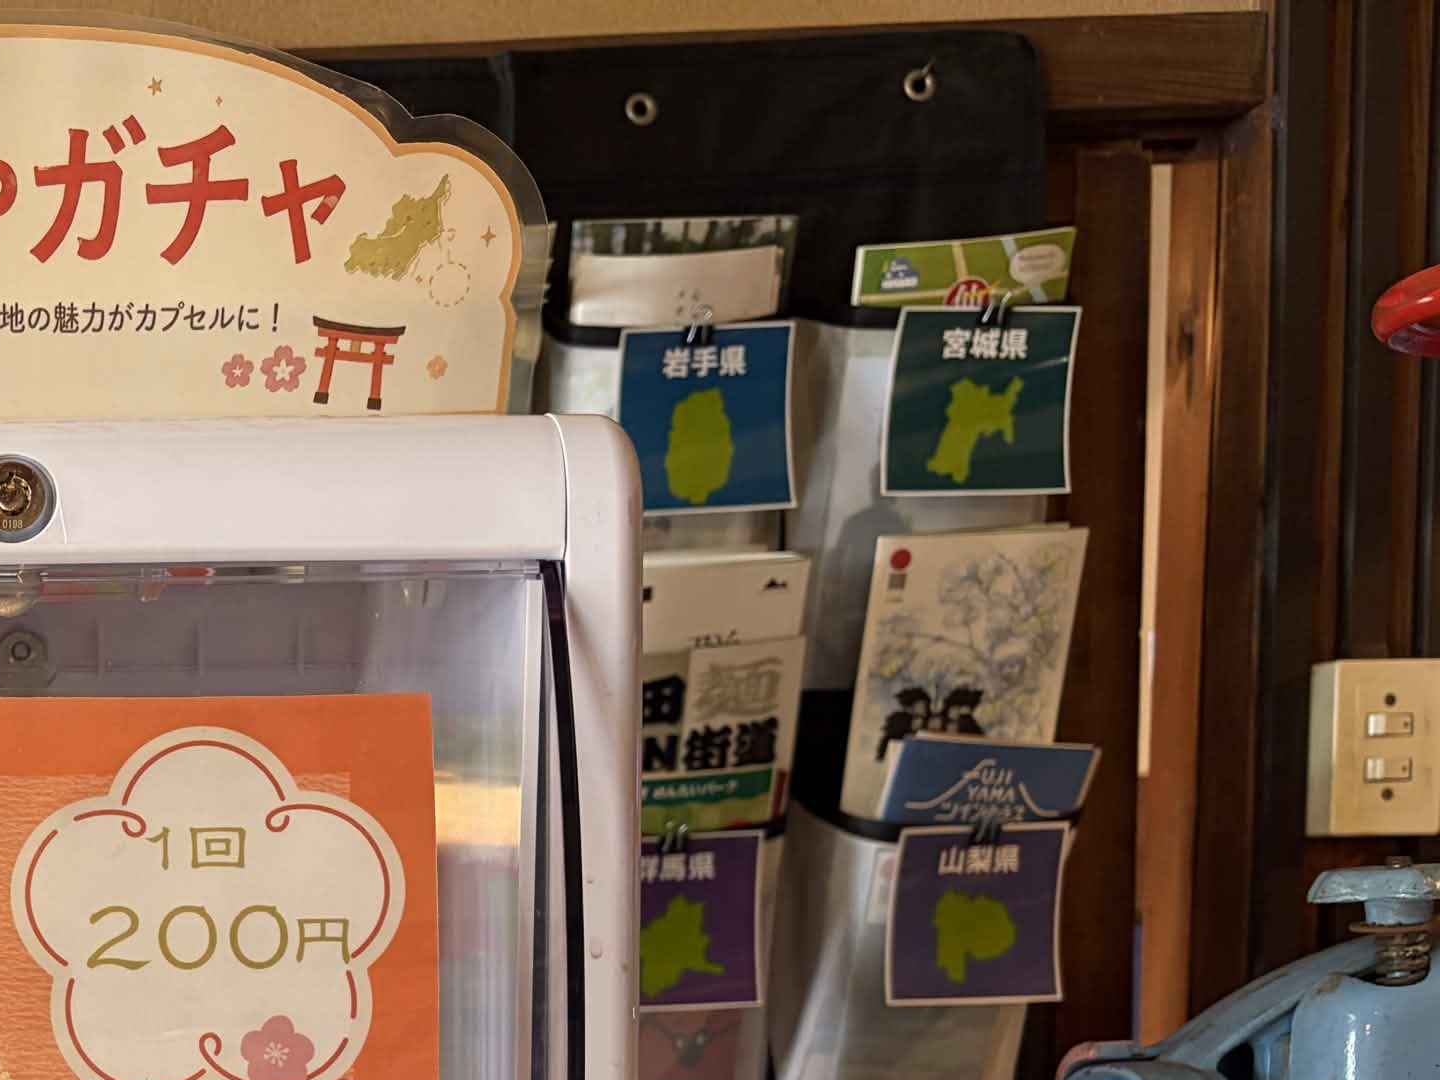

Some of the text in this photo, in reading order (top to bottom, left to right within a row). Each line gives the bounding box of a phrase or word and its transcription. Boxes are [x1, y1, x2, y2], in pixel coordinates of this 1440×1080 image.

[943, 328, 1028, 360] 宮城県
[662, 345, 747, 378] 岩手県
[145, 826, 247, 871] 1回
[937, 844, 1021, 876] 山梨県
[86, 904, 351, 971] 200円
